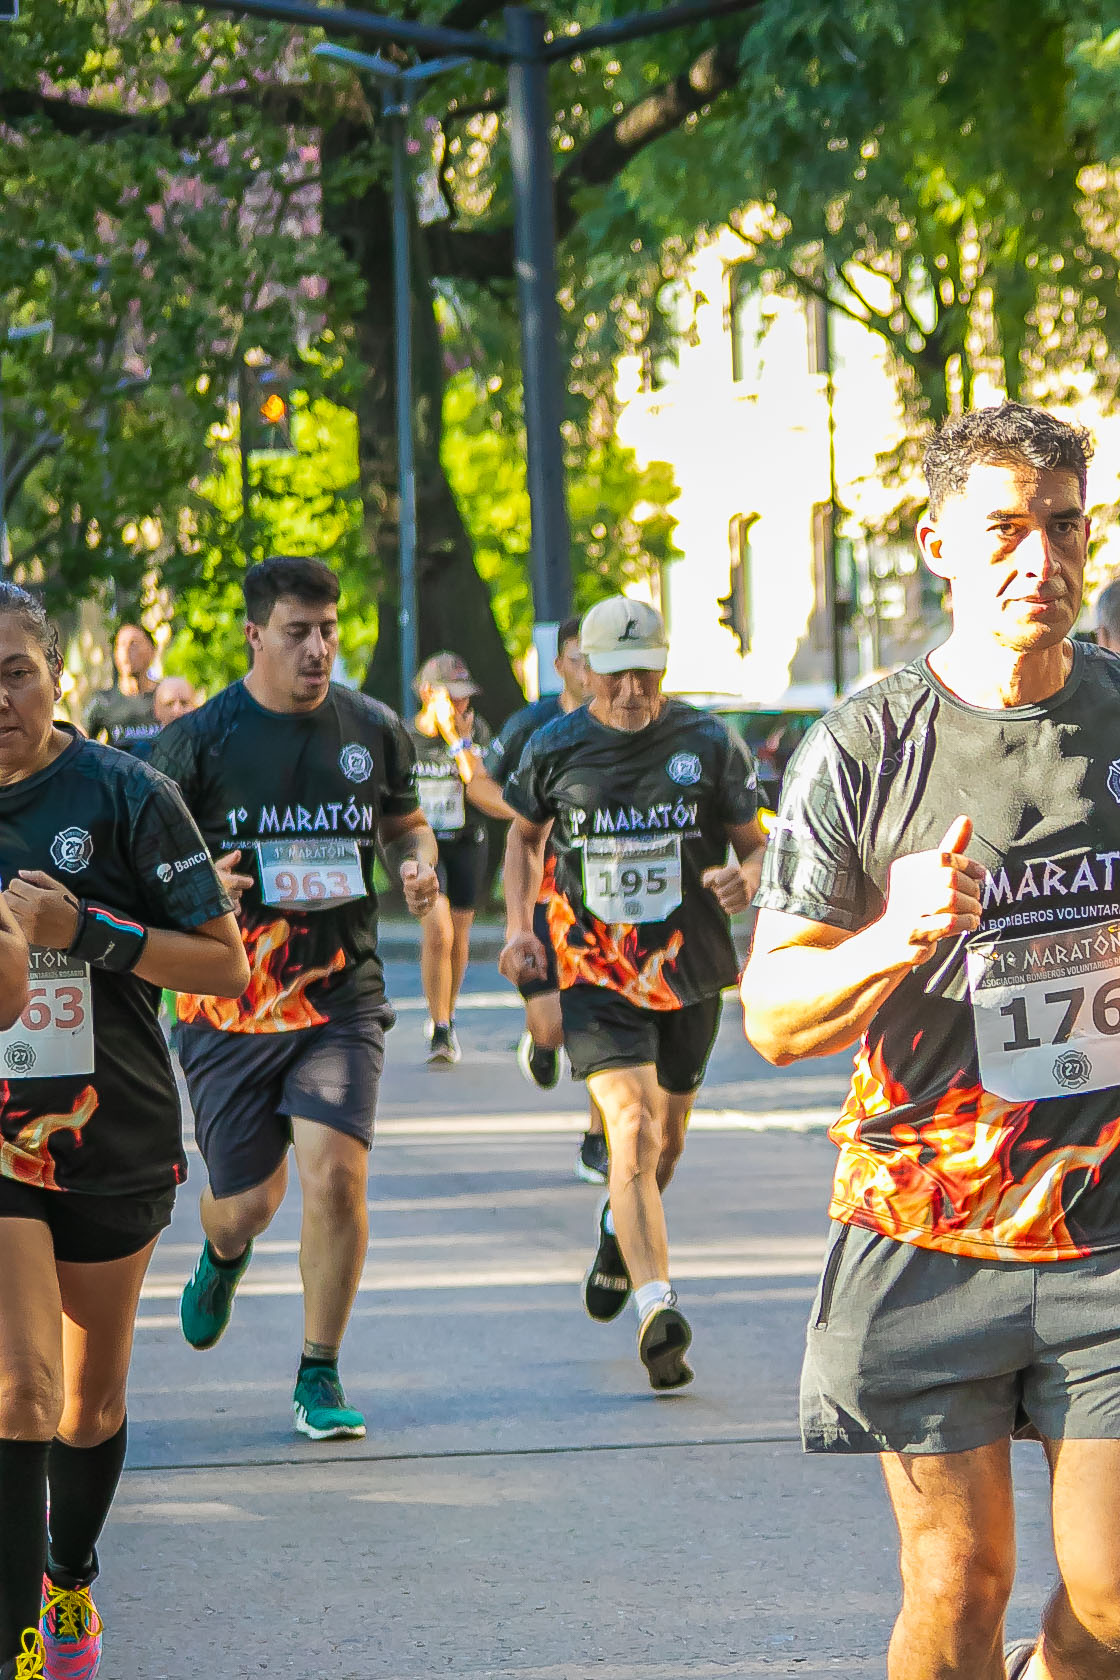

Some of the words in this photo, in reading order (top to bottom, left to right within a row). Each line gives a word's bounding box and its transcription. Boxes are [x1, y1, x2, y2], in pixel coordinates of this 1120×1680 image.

[258, 794, 373, 834] MARATÓN
[174, 850, 208, 874] Banco
[274, 871, 351, 901] 963
[598, 866, 669, 898] 195
[989, 909, 1054, 931] BOMBEROS
[1026, 967, 1066, 983] BOMBEROS
[1067, 958, 1114, 975] VOLUNTARIOS
[13, 1051, 27, 1065] 27
[1065, 1062, 1080, 1077] 27
